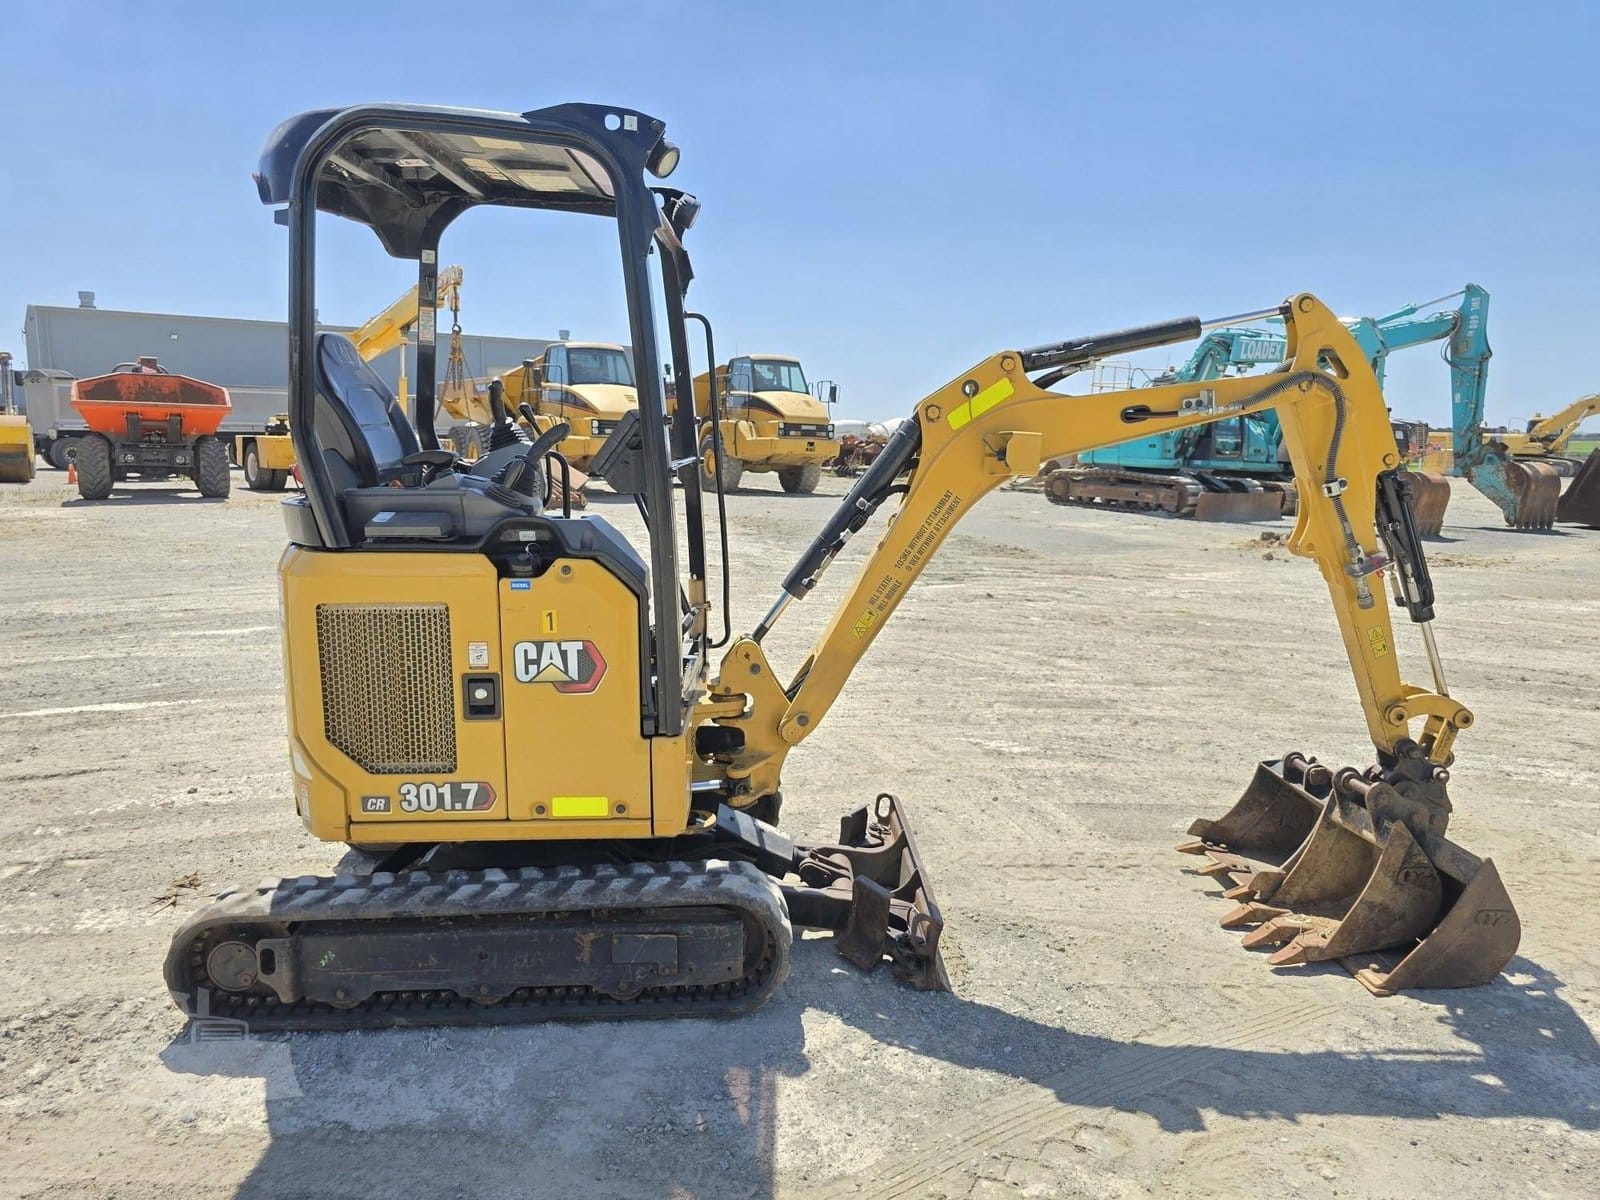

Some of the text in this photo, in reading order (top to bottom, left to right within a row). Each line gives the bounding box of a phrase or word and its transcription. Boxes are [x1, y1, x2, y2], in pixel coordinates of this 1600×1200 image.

[1240, 340, 1281, 359] LOADEX
[868, 490, 953, 606] WLL STATIC 103KG WITHOUT ATTACHMENT
[877, 600, 889, 612] WLL
[884, 580, 903, 600] MOBILE
[917, 530, 937, 556] WITHOUT
[933, 495, 962, 533] ATTACHMENT
[546, 611, 554, 631] 1
[514, 641, 583, 682] CAT
[366, 783, 479, 811] CR 301.7
